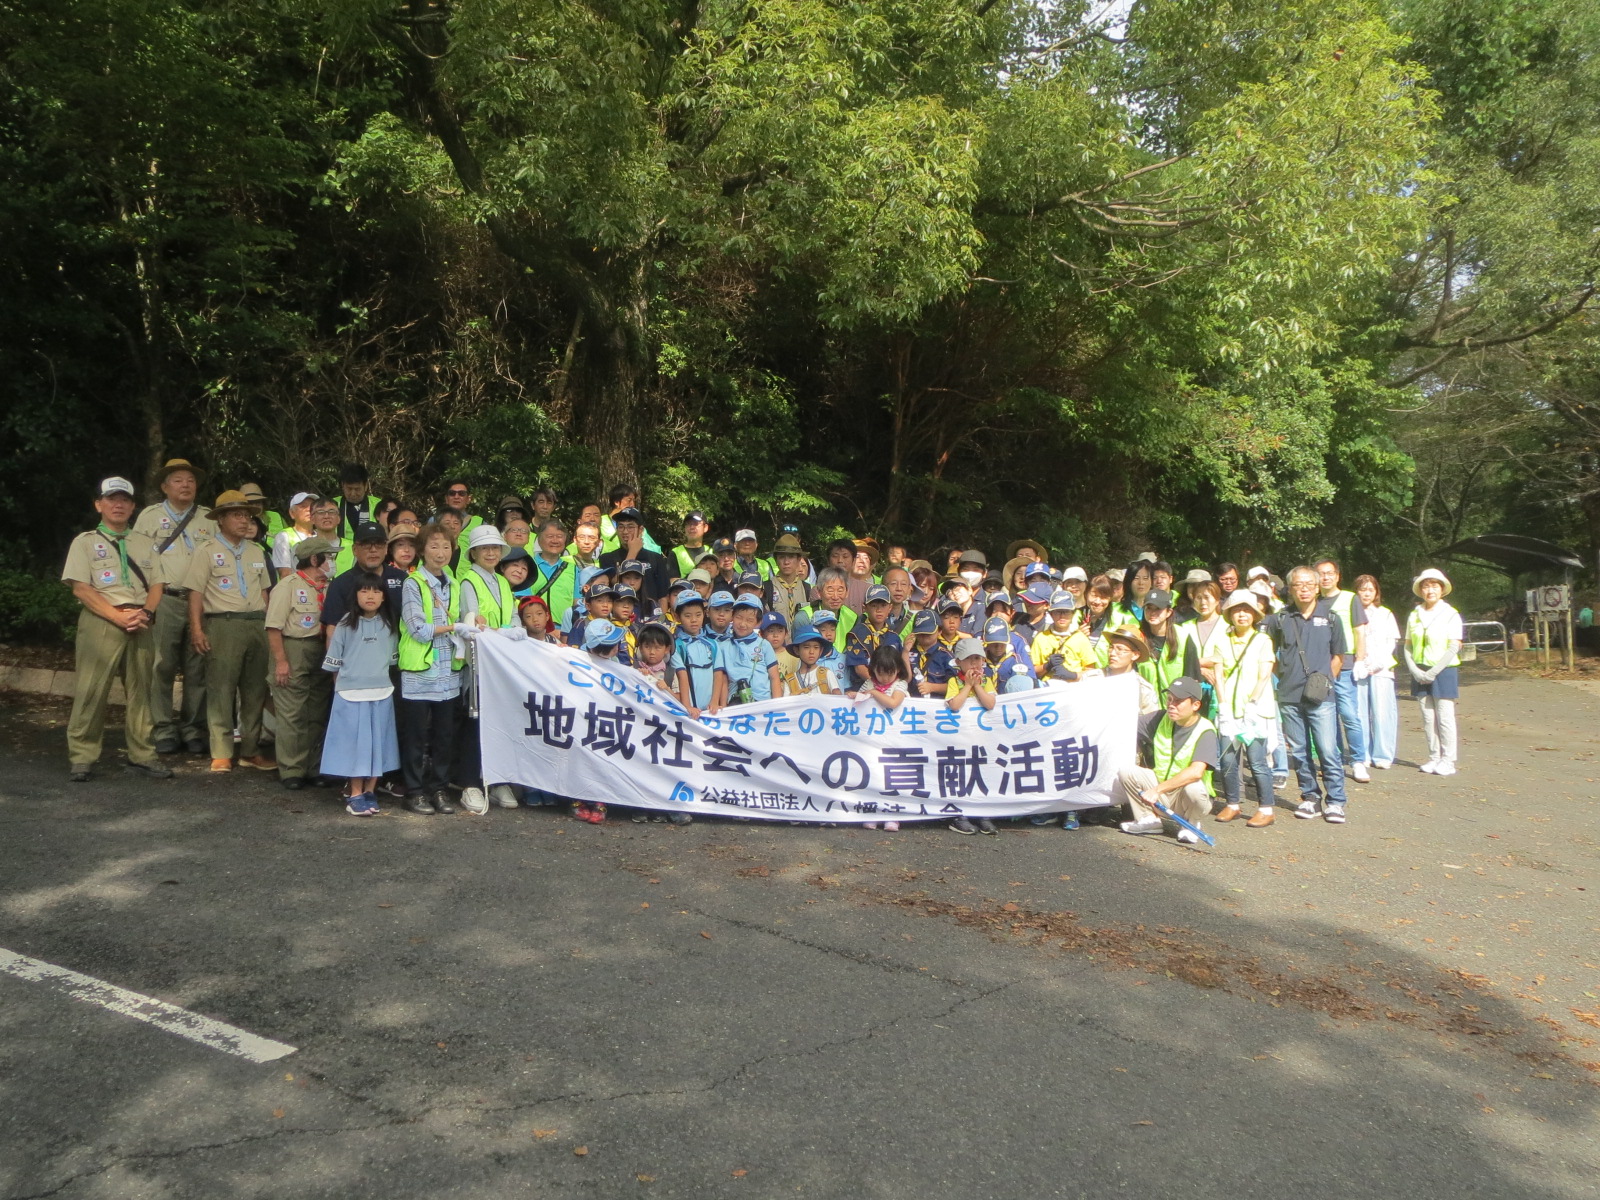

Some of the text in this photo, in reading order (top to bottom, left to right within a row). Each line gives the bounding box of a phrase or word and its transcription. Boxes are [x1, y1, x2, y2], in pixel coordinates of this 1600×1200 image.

[523, 691, 1099, 799] 地域社会への貢献活動
